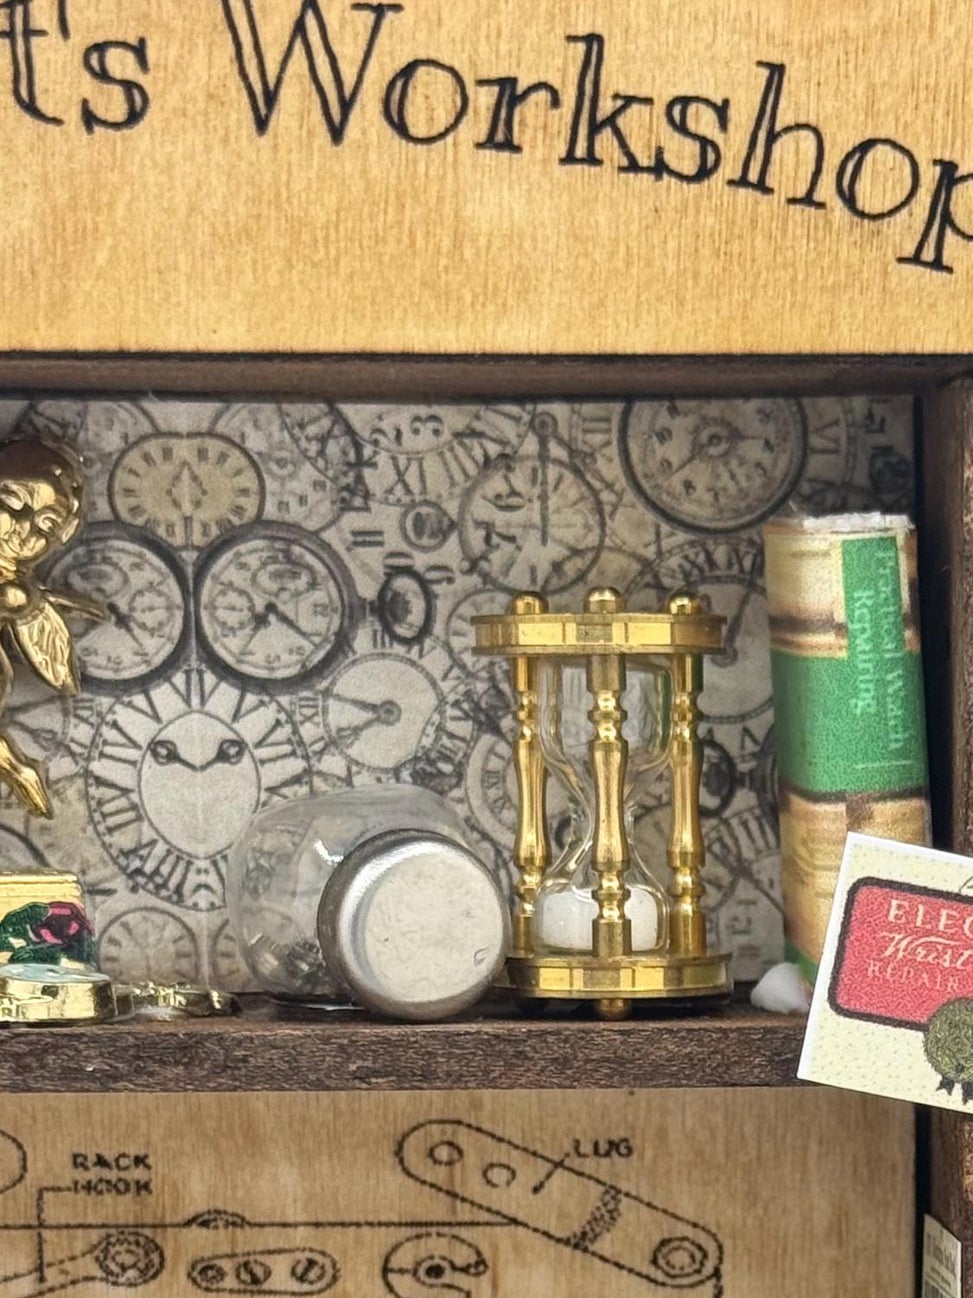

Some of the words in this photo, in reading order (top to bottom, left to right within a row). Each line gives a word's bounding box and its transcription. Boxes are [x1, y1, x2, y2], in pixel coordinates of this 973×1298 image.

[573, 1138, 634, 1159] LUG
[72, 1152, 152, 1172] RACK
[72, 1177, 154, 1197] HOOK
